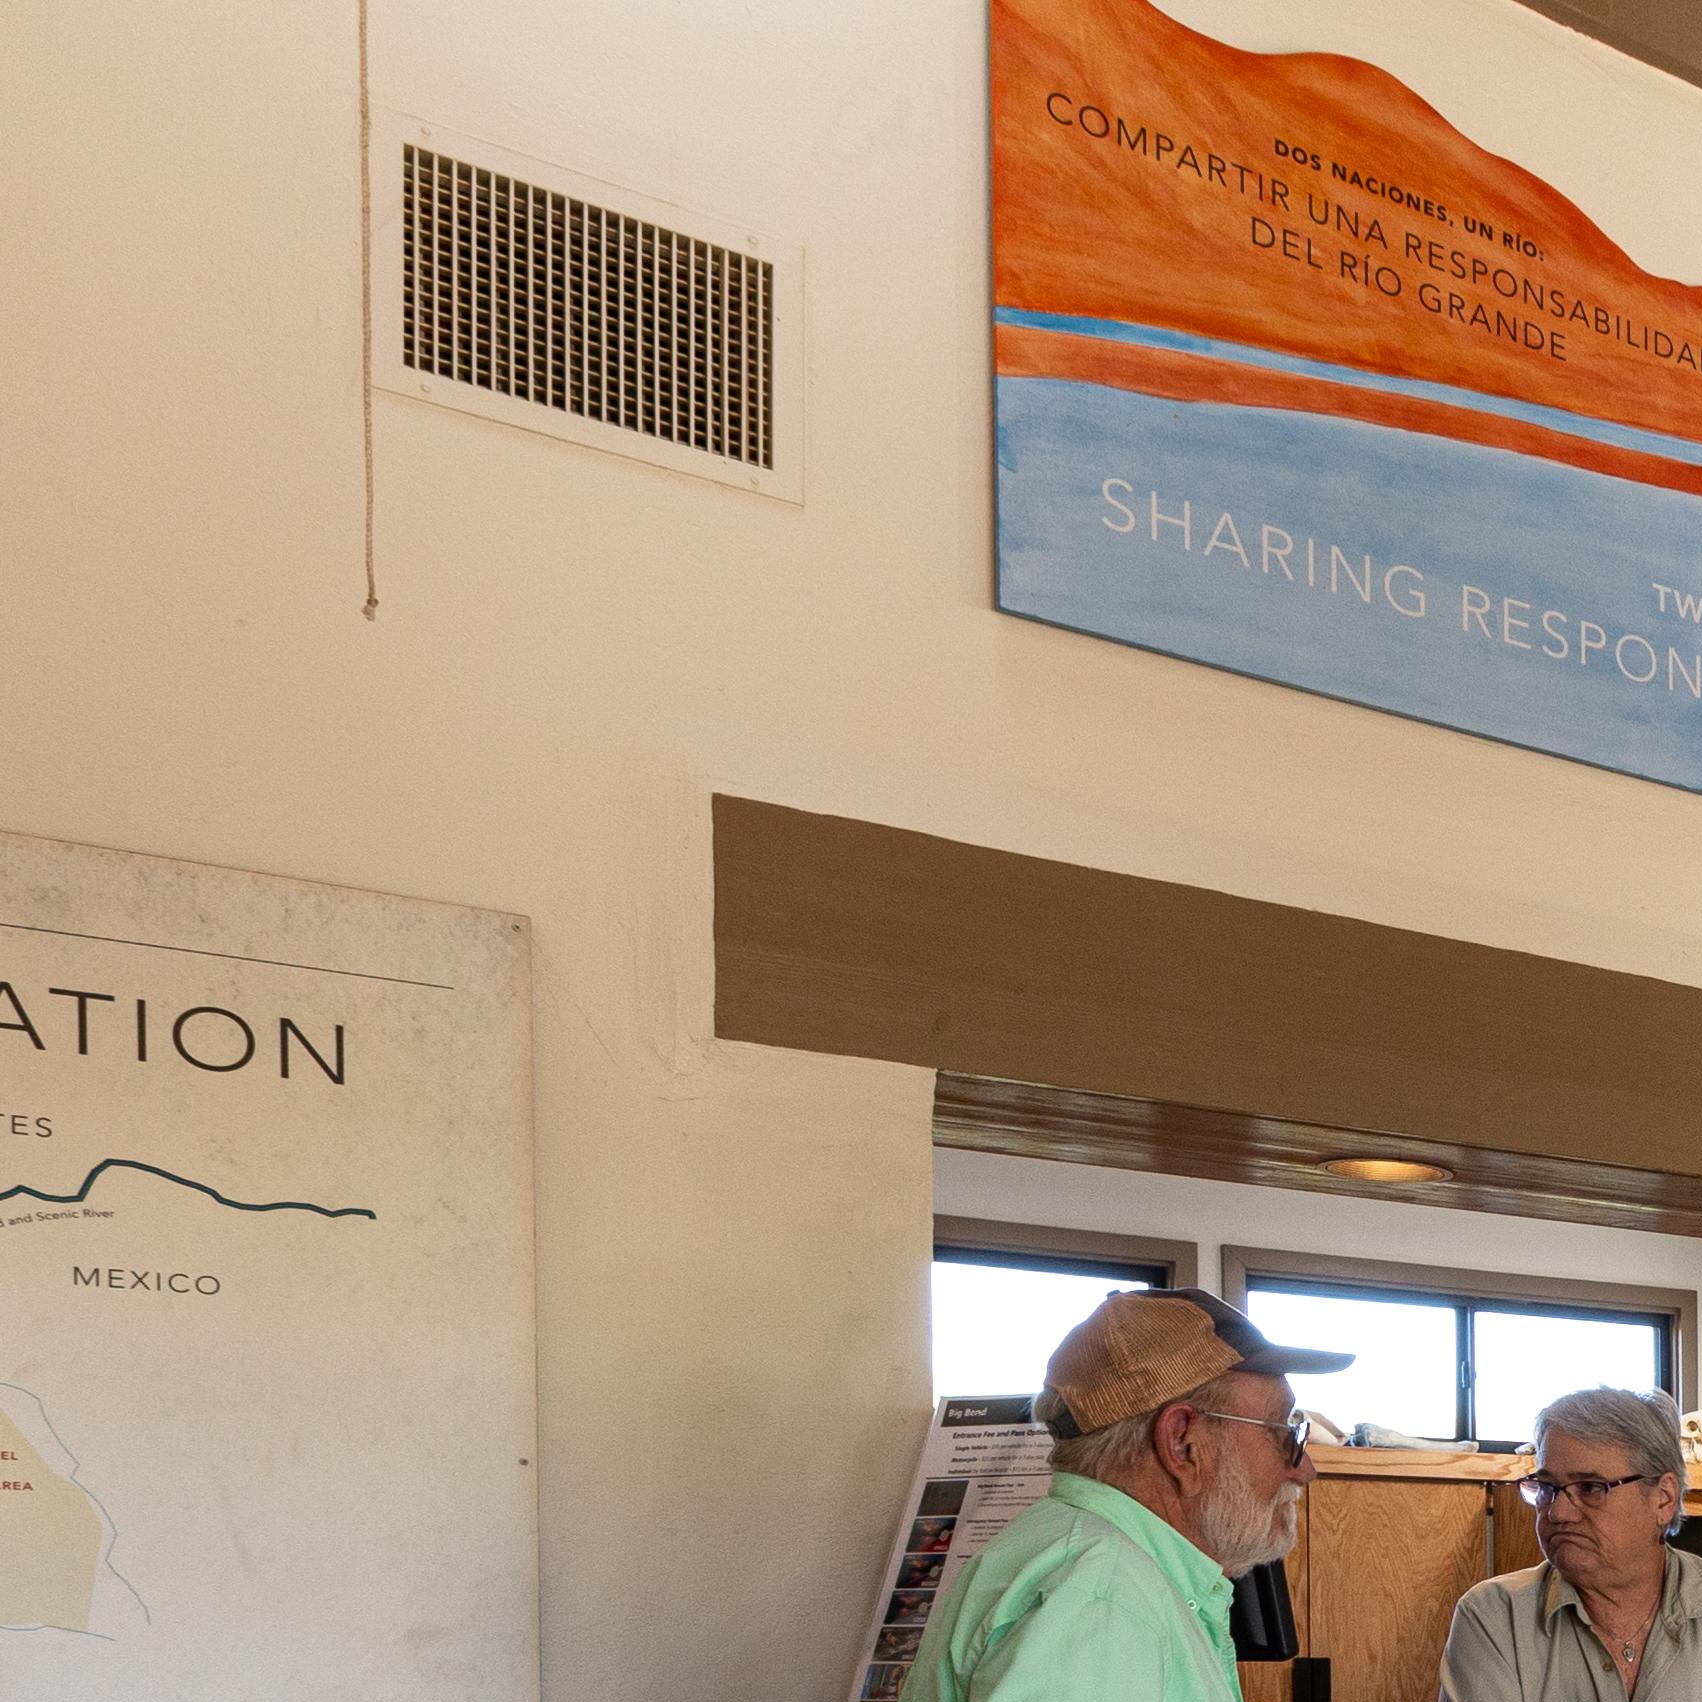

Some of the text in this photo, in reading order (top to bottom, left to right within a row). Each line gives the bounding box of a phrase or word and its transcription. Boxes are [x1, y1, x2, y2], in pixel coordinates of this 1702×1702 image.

[1046, 93, 1290, 211] COMPARTIR
[1308, 193, 1388, 249] UNA
[1274, 139, 1544, 261] DOS NACIONES, UN RÍO:
[1251, 216, 1567, 362] DEL RÍO GRANDE
[1101, 478, 1426, 618] SHARING
[9, 1208, 115, 1226] and Scenic River
[73, 1266, 221, 1295] MEXICO
[948, 1407, 987, 1418] Big Bend
[0, 1481, 33, 1491] REA
